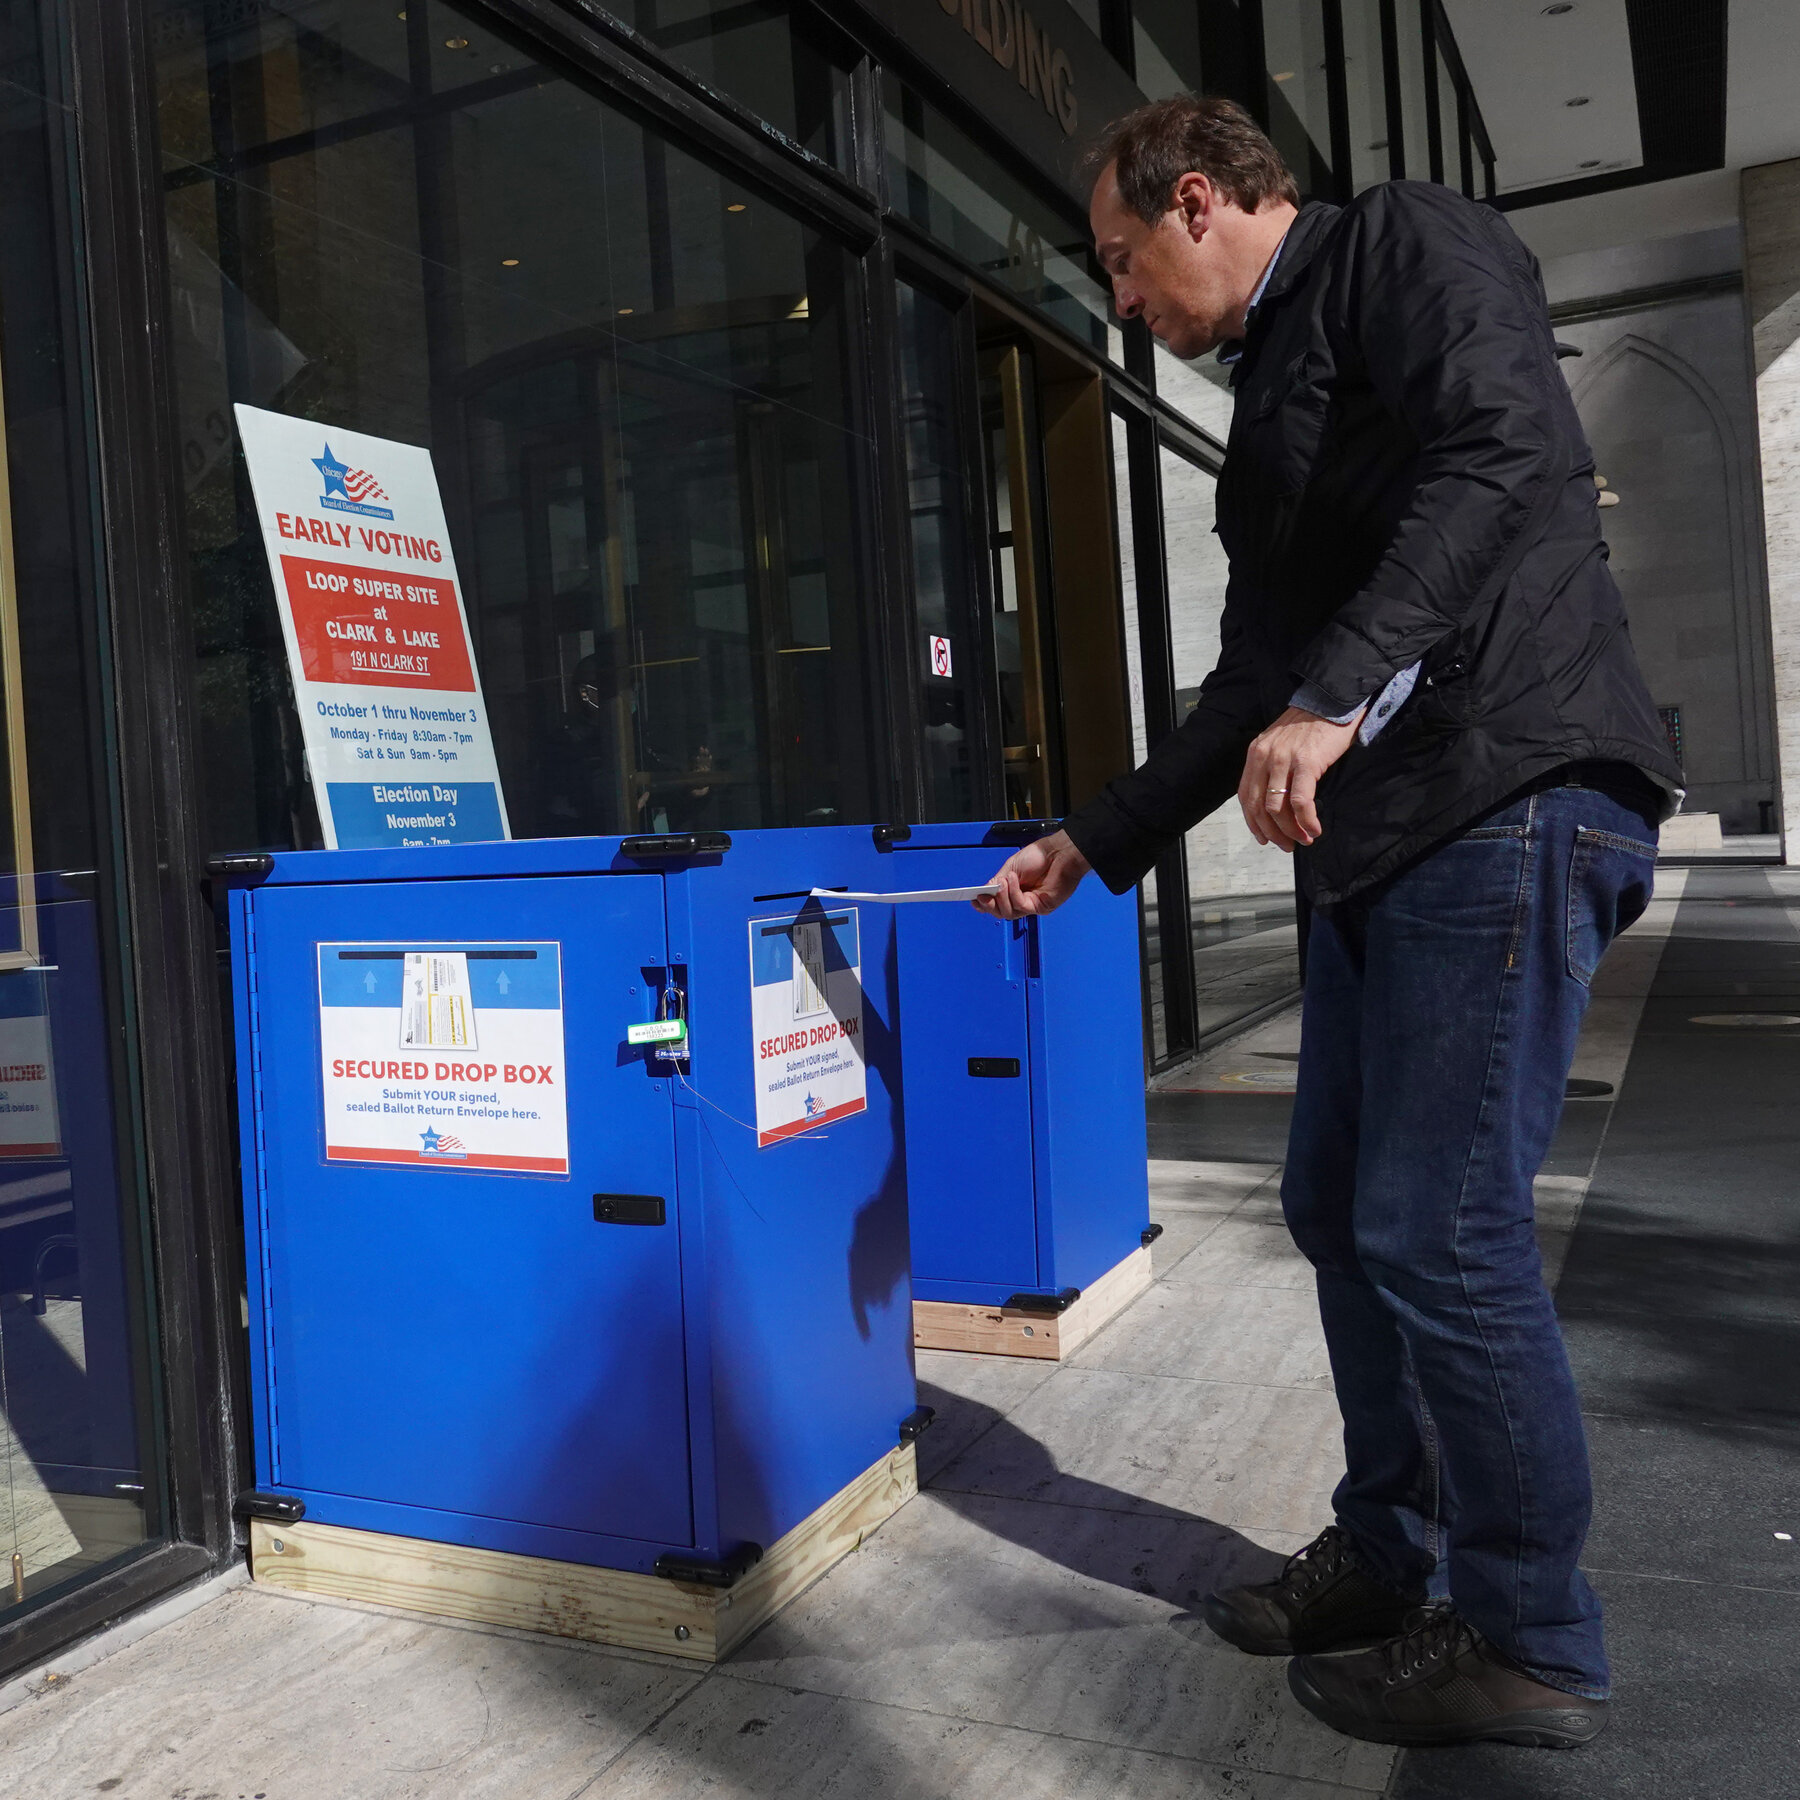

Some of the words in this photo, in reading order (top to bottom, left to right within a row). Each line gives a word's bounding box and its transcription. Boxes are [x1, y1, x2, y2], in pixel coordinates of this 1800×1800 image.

[937, 0, 1078, 136] LDING
[276, 512, 352, 548] EARLY
[358, 527, 442, 563] VOTING
[306, 570, 349, 593] LOOP
[354, 577, 404, 600] SUPER
[407, 586, 440, 606] SITE
[374, 606, 388, 620] at
[326, 620, 378, 642] CLARK
[385, 627, 396, 644] &
[402, 629, 440, 648] LAKE
[350, 650, 368, 668] 191
[370, 652, 378, 668] N
[380, 652, 414, 671] CLARK
[415, 656, 429, 672] ST
[316, 701, 368, 718] October
[372, 704, 378, 718] 1
[382, 704, 407, 720] thru
[410, 706, 466, 722] November
[469, 709, 477, 723] 3
[330, 727, 370, 744] Monday
[378, 728, 408, 744] Friday
[413, 730, 447, 743] 8:30am
[454, 732, 473, 745] 7pm
[356, 747, 374, 760] Sat
[377, 748, 385, 760] &
[387, 748, 406, 760] Sun
[410, 749, 430, 760] 9am
[438, 750, 458, 762] 5pm
[372, 785, 430, 803] Election
[433, 786, 458, 805] Day
[386, 813, 446, 829] November
[448, 813, 456, 827] 3
[402, 838, 423, 848] 6am
[431, 837, 450, 846] 7pm
[760, 1029, 808, 1060] SECURED
[810, 1022, 837, 1044] DROP
[839, 1016, 859, 1038] BOX
[332, 1059, 429, 1082] SECURED
[435, 1062, 498, 1083] DROP
[504, 1064, 554, 1085] BOX
[786, 1058, 804, 1073] Submit
[805, 1055, 820, 1067] YOUR
[821, 1049, 839, 1065] signed,
[768, 1077, 786, 1092] sealed
[786, 1072, 802, 1087] Ballot
[802, 1068, 820, 1084] Return
[820, 1062, 843, 1077] Envelope
[842, 1059, 854, 1071] here.
[382, 1088, 422, 1101] Submit
[424, 1090, 456, 1102] YOUR
[458, 1090, 500, 1105] signed,
[346, 1101, 380, 1113] sealed
[383, 1102, 415, 1114] Ballot
[417, 1103, 454, 1116] Return
[457, 1104, 509, 1120] Envelope
[511, 1106, 541, 1120] here.
